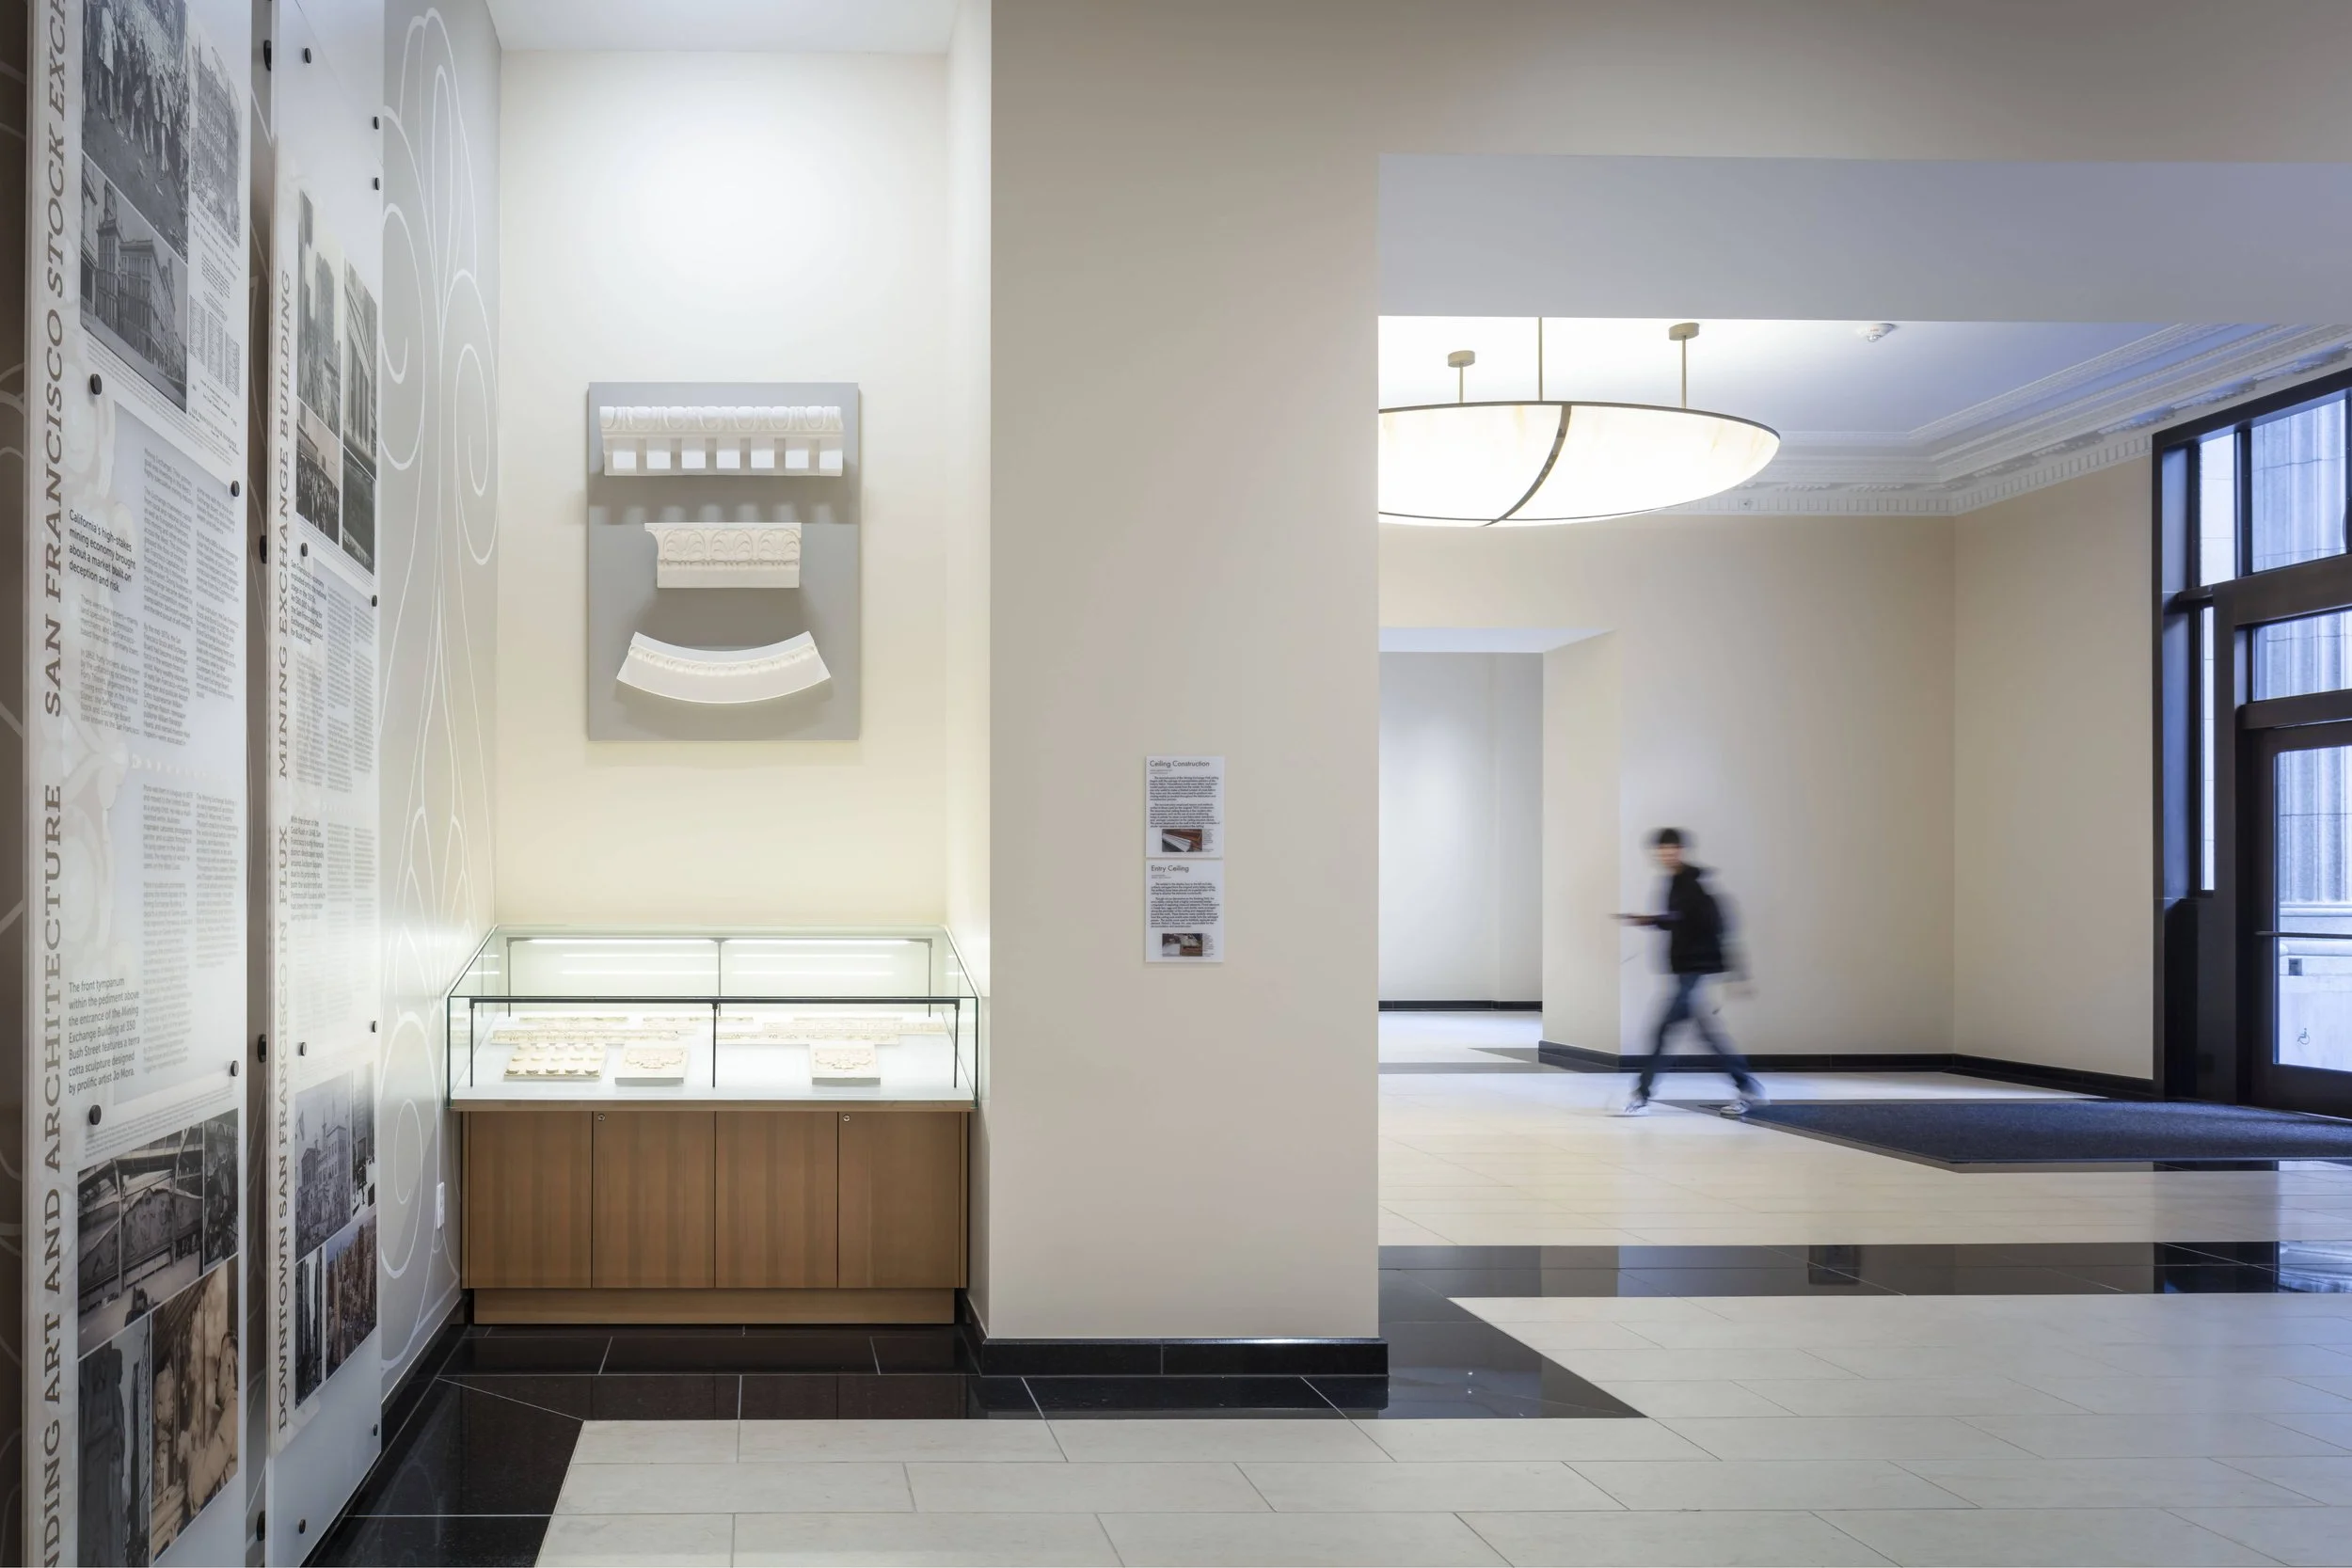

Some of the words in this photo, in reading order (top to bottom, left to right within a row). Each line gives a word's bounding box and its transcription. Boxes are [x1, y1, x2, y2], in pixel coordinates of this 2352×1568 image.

[47, 121, 67, 301] STOCK
[278, 270, 292, 441] BUILDING
[45, 309, 65, 604] FRANCISCO
[70, 509, 101, 535] California's
[102, 527, 132, 552] high-stakes
[70, 529, 88, 546] mining
[90, 540, 115, 561] economy
[116, 551, 135, 569] brought
[278, 449, 289, 638] EXCHANGE
[70, 545, 86, 560] about
[92, 555, 110, 573] market
[124, 573, 131, 581] on
[70, 561, 98, 580] deception
[99, 576, 108, 587] and
[110, 579, 119, 593] risk.
[45, 613, 62, 717] SAN
[278, 643, 289, 779] MINING
[278, 825, 288, 906] FLUX
[278, 920, 288, 955] IN
[44, 784, 62, 1173] ARCHITECTURE
[69, 982, 79, 993] The
[81, 979, 95, 991] front
[97, 977, 124, 991] tympanum
[69, 996, 87, 1010] within
[88, 997, 97, 1006] the
[99, 992, 122, 1007] pediment
[124, 990, 139, 1001] above
[69, 1015, 78, 1026] the
[80, 1012, 103, 1025] entrance
[105, 1009, 110, 1020] of
[112, 1007, 120, 1018] the
[121, 1006, 138, 1017] Mining
[69, 1029, 97, 1043] Exchange
[98, 1024, 119, 1038] Building
[120, 1023, 125, 1033] at
[127, 1020, 135, 1031] 350
[69, 1048, 83, 1060] Bush
[85, 1043, 101, 1056] Street
[103, 1038, 122, 1052] features
[128, 1036, 139, 1046] terra
[69, 1064, 84, 1077] cotta
[86, 1056, 110, 1072] sculpture
[112, 1051, 135, 1066] designed
[278, 962, 288, 1148] FRANCISCO
[69, 1083, 75, 1096] by
[77, 1075, 97, 1095] prolific
[99, 1071, 112, 1085] artist
[114, 1069, 119, 1081] Jo
[120, 1067, 135, 1078] Mora.
[278, 1155, 289, 1218] SAN
[44, 1188, 61, 1294] AND
[44, 1314, 61, 1405] ART
[278, 1227, 289, 1433] DOWNTOWN
